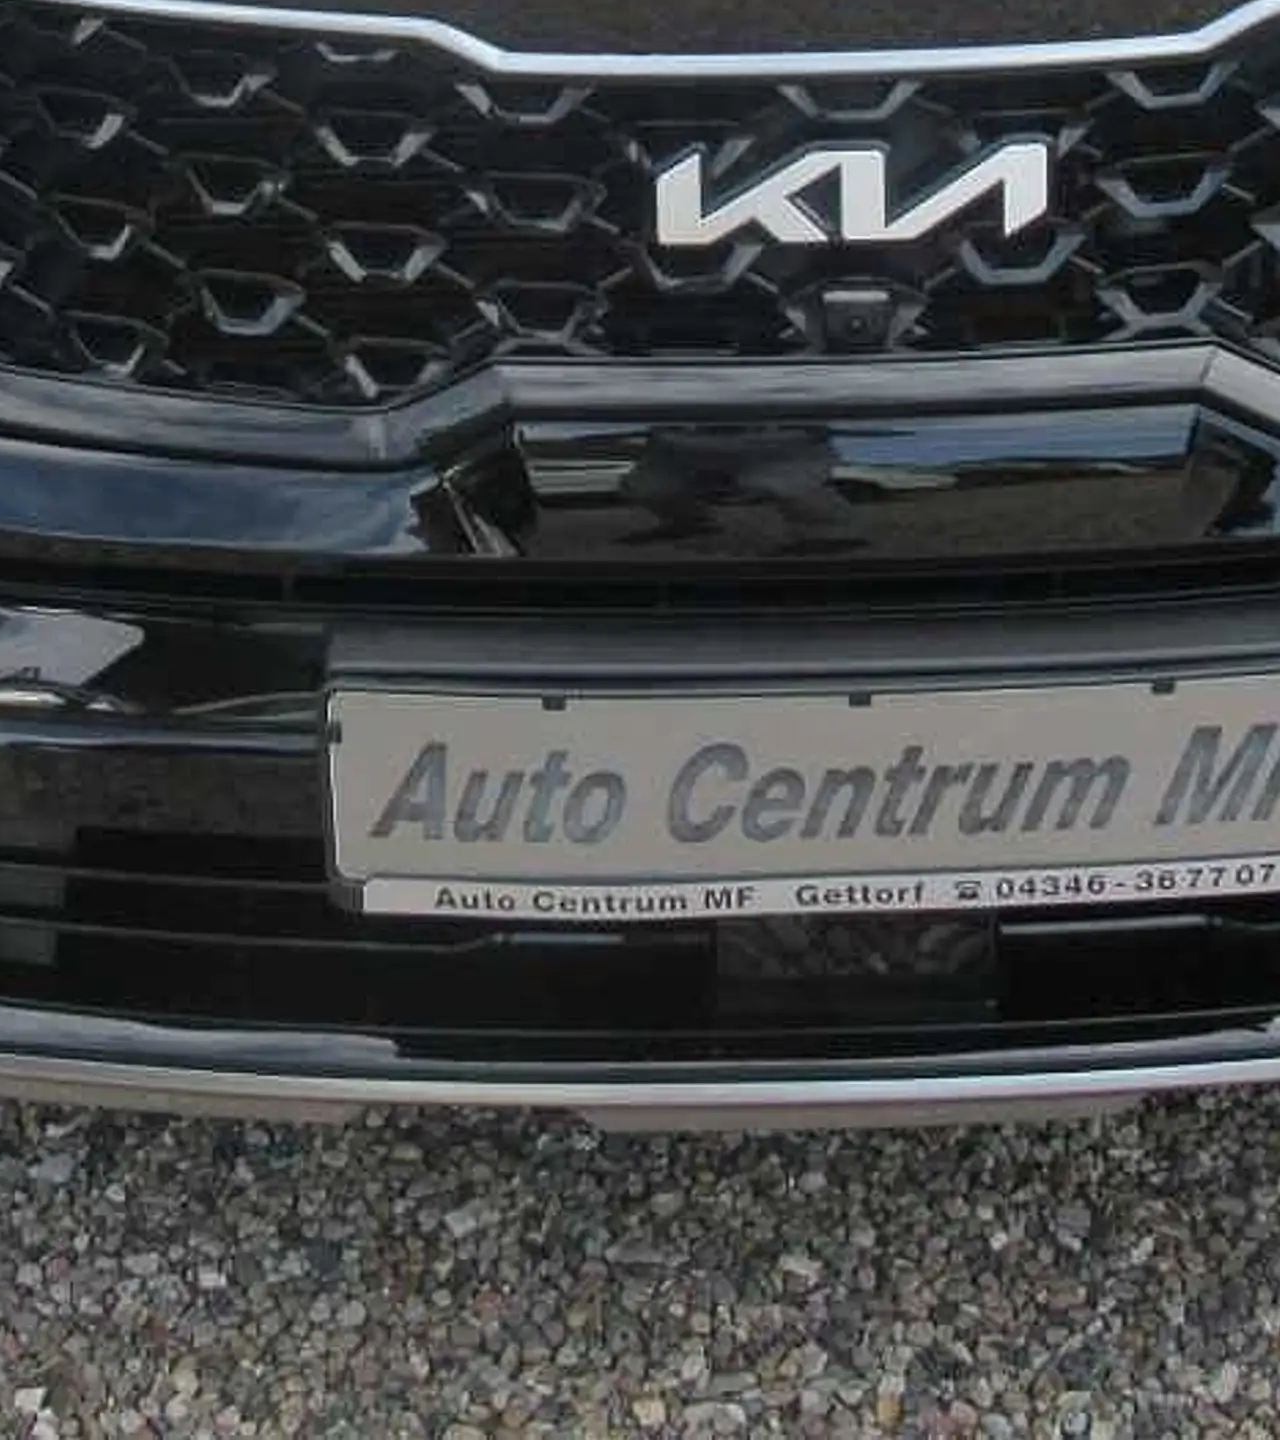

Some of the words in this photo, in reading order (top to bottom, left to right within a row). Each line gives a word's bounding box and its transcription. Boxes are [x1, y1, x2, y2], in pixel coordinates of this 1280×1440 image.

[656, 142, 1049, 247] KIA
[369, 739, 628, 844] Auto
[667, 741, 1132, 844] Centrum
[434, 885, 516, 912] Auto
[532, 888, 688, 914] Centrum
[703, 886, 757, 911] MF
[795, 882, 924, 907] Gettorf
